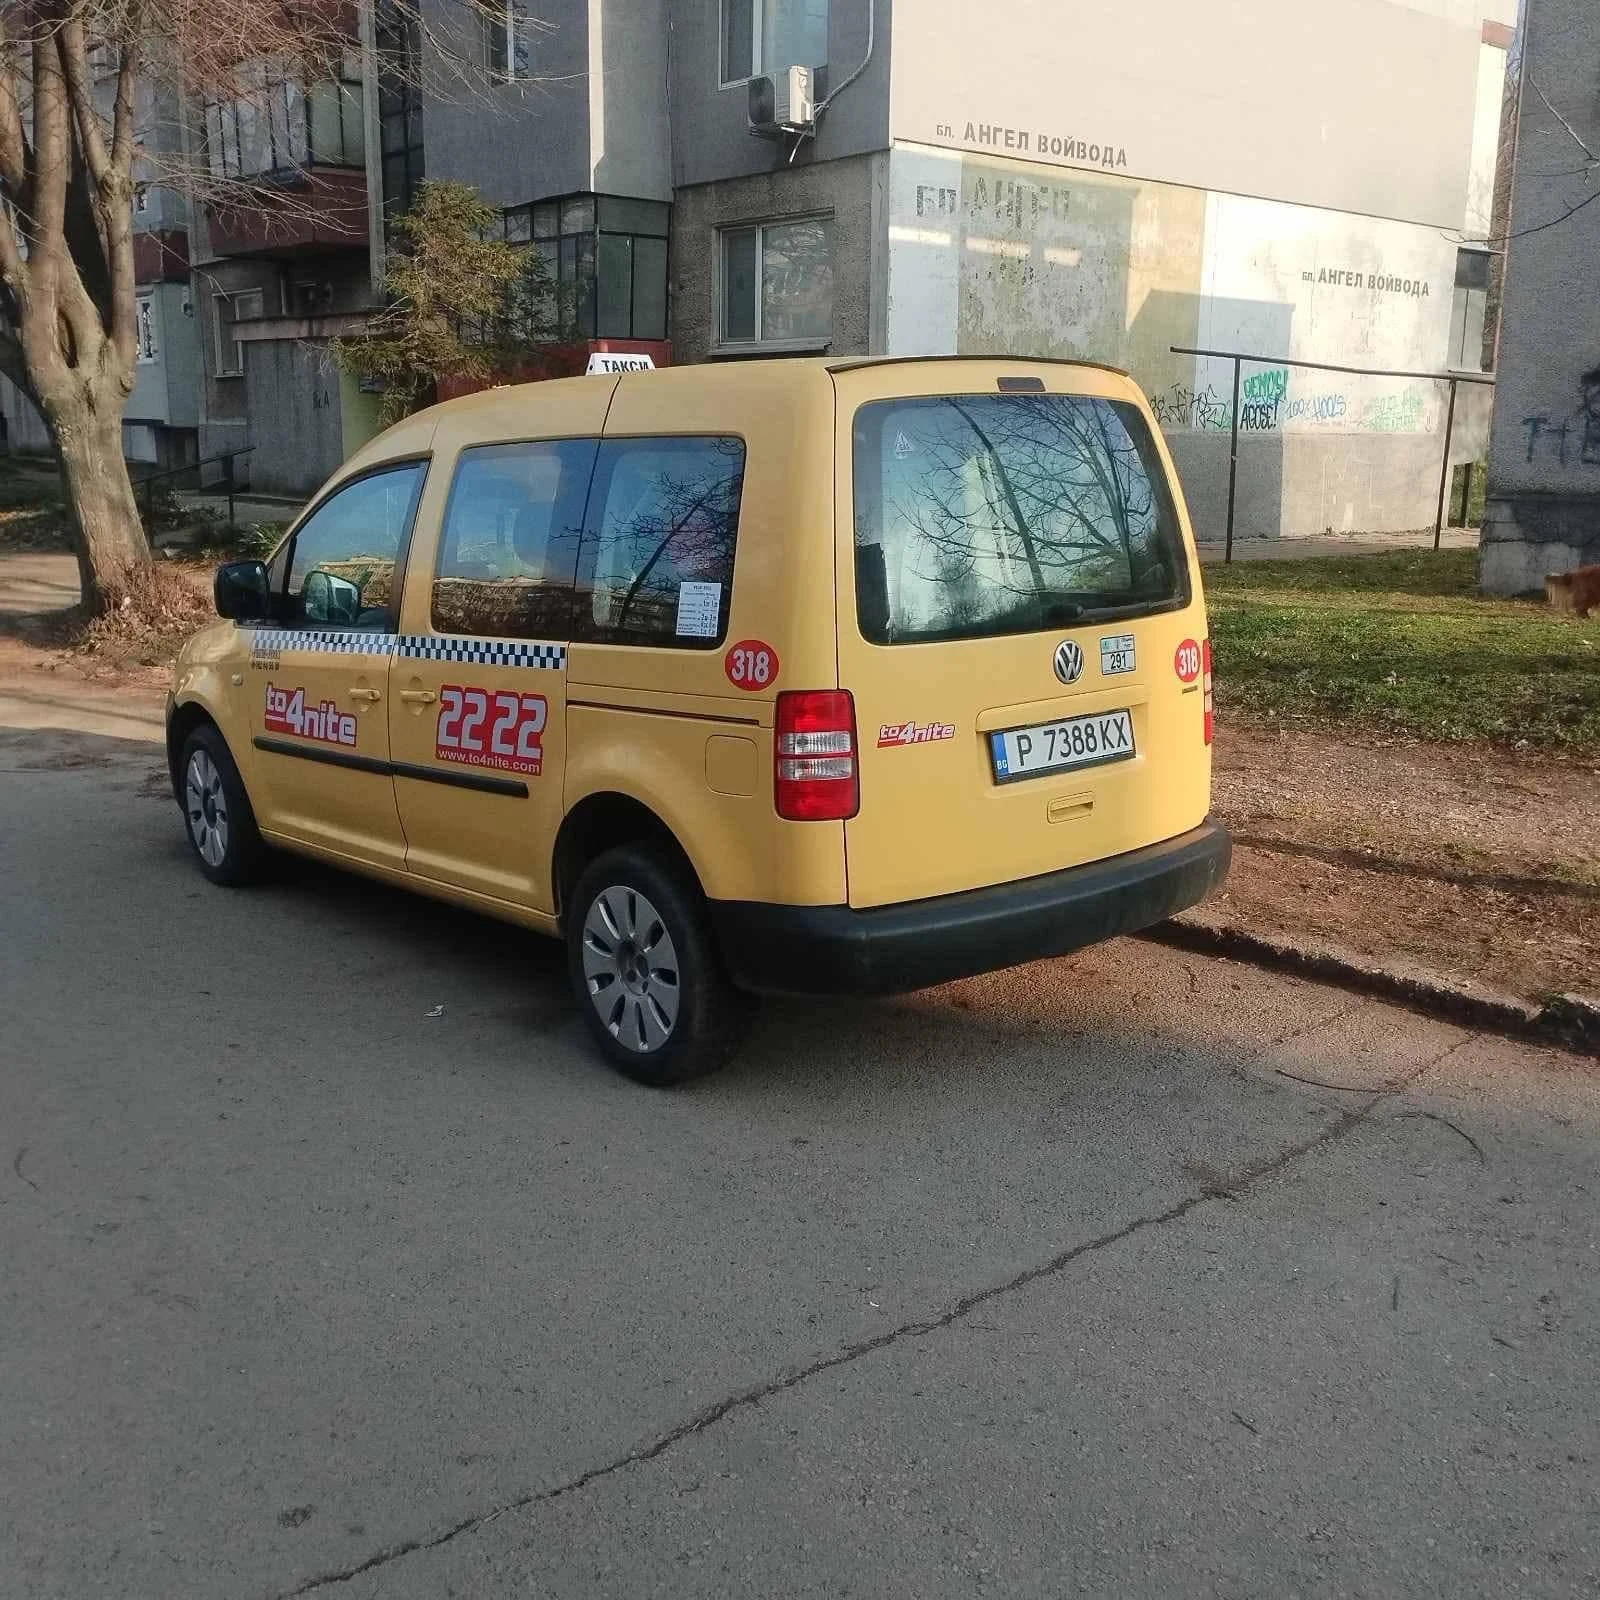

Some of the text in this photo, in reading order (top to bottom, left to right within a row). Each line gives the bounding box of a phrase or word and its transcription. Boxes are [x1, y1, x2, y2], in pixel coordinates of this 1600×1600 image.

[964, 121, 1029, 151] АНГЕЛ
[1037, 135, 1127, 168] ВОЙВОДА
[1318, 267, 1363, 288] АНГЕЛ
[1367, 274, 1430, 298] ВОЙВОДА
[601, 360, 649, 373] ТАКСИ
[732, 649, 769, 683] 318
[1111, 651, 1126, 670] 291
[1178, 647, 1198, 675] 318
[266, 683, 357, 746] to4nite
[879, 721, 956, 744] to4nite
[997, 716, 1128, 769] BG P 7388 KX
[439, 750, 540, 774] www.to4nite.com
